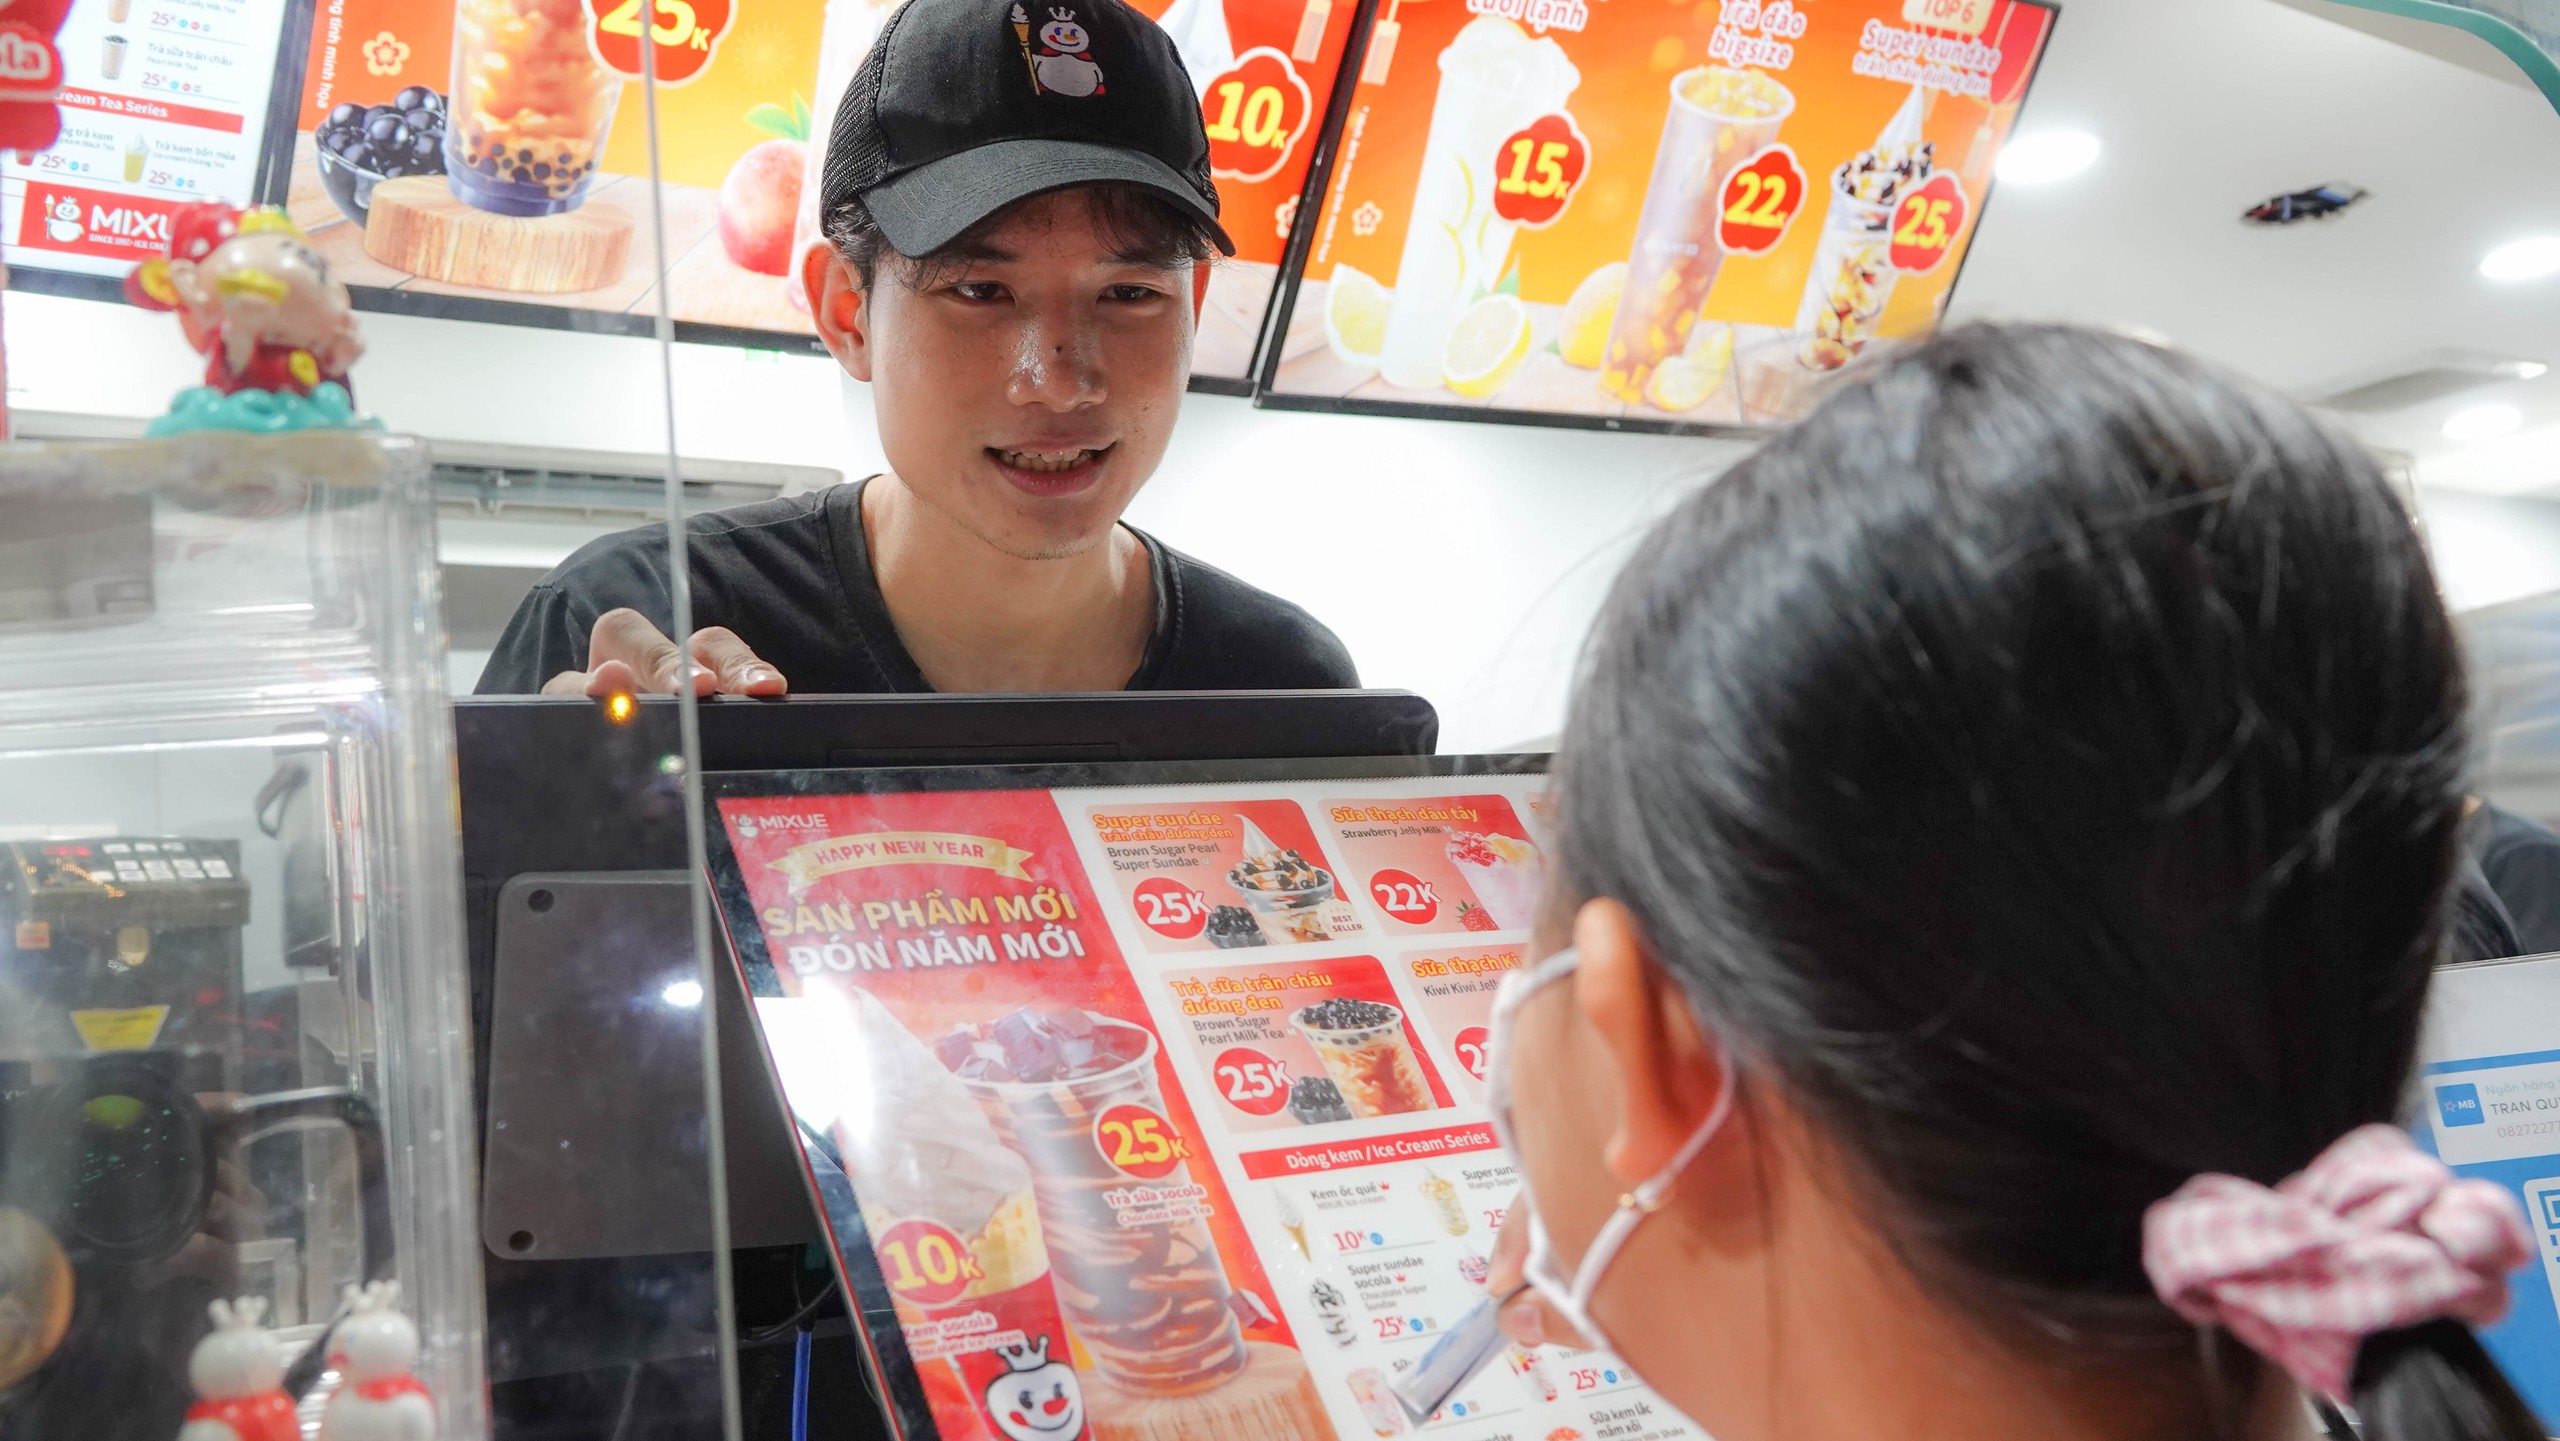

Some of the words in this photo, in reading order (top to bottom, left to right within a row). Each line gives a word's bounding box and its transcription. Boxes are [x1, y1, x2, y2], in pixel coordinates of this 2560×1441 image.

[1527, 0, 1587, 31] lạnh
[1922, 0, 1961, 20] TOP
[1961, 1, 1977, 23] 6
[1710, 27, 1793, 68] bigsize
[1861, 20, 1926, 58] Super
[1926, 38, 2001, 72] sundae
[321, 45, 338, 80] minh
[54, 91, 96, 106] ream
[98, 95, 123, 110] Tea
[124, 99, 169, 118] Series
[1206, 80, 1289, 151] 10K
[1497, 138, 1572, 200] 15K
[1724, 171, 1788, 228] 22K
[89, 204, 172, 240] MIXU
[1893, 195, 1955, 250] 25K
[758, 813, 828, 830] MIXUE
[1093, 814, 1150, 832] Super
[1153, 810, 1223, 827] sundae
[1331, 806, 1366, 823] Sữa
[1367, 805, 1416, 824] thạch
[1418, 806, 1450, 821] dâu
[1449, 805, 1478, 823] tây
[1100, 830, 1131, 842] trân
[1132, 828, 1165, 841] châu
[1207, 828, 1234, 839] đen
[1342, 827, 1398, 839] Strawberry
[1400, 826, 1422, 837] Jelly
[1423, 826, 1442, 835] Milk
[814, 842, 876, 865] HAPPY
[882, 840, 927, 855] NEW
[932, 840, 985, 858] YEAR
[1107, 846, 1150, 858] Brown
[1150, 844, 1187, 857] Sugar
[1188, 842, 1221, 853] Pearl
[1113, 860, 1150, 872] Super
[1151, 857, 1199, 869] Sundae
[862, 888, 990, 930] PHẨM
[994, 885, 1078, 924] MỚI
[1138, 890, 1214, 925] 25K
[1374, 882, 1444, 912] 22K
[1331, 914, 1353, 923] BEST
[1333, 923, 1364, 932] SELLER
[788, 934, 892, 976] ĐÓN
[897, 929, 997, 968] NĂM
[1002, 922, 1087, 962] MỚI
[1411, 959, 1448, 978] Sữa
[1448, 954, 1501, 977] thạch
[1170, 978, 1207, 997] Trà
[1208, 977, 1243, 994] sữa
[1243, 974, 1287, 992] trân
[1288, 971, 1334, 988] châu
[1423, 984, 1450, 997] Kiwi
[1450, 981, 1478, 994] Kiwi
[1183, 996, 1247, 1016] đường
[1247, 995, 1284, 1011] đen
[1193, 1018, 1235, 1032] Brown
[1235, 1016, 1271, 1030] Sugar
[1199, 1032, 1234, 1046] Pearl
[1235, 1030, 1260, 1042] Milk
[1262, 1028, 1285, 1040] Tea
[1217, 1060, 1296, 1101] 25K
[2522, 1080, 2556, 1092] hàng
[2457, 1098, 2477, 1110] MB
[2490, 1100, 2532, 1115] TRAN
[2535, 1096, 2560, 1111] QU
[1100, 1116, 1194, 1166] 25K
[1286, 1150, 1331, 1171] Dòng
[1329, 1147, 1363, 1164] kem
[1373, 1142, 1396, 1158] Ice
[1396, 1138, 1446, 1157] Cream
[1446, 1130, 1491, 1150] Series
[1462, 1168, 1493, 1181] Super
[1104, 1189, 1132, 1207] Trà
[1133, 1188, 1159, 1204] sữa
[1159, 1183, 1205, 1201] socola
[1310, 1189, 1338, 1200] Kem
[1339, 1184, 1354, 1197] ốc
[1119, 1209, 1169, 1224] Chocolate
[1170, 1206, 1191, 1218] Milk
[1192, 1204, 1213, 1217] Tea
[1333, 1230, 1368, 1251] 10K
[880, 1233, 985, 1293] 10K
[1348, 1263, 1382, 1276] Super
[1383, 1256, 1425, 1271] sundae
[1355, 1275, 1392, 1289] socola
[941, 1314, 995, 1333] socola
[1372, 1316, 1407, 1338] 25K
[1569, 1368, 1602, 1390] 25K
[1589, 1410, 1611, 1425] Sữa
[1611, 1407, 1636, 1420] kem
